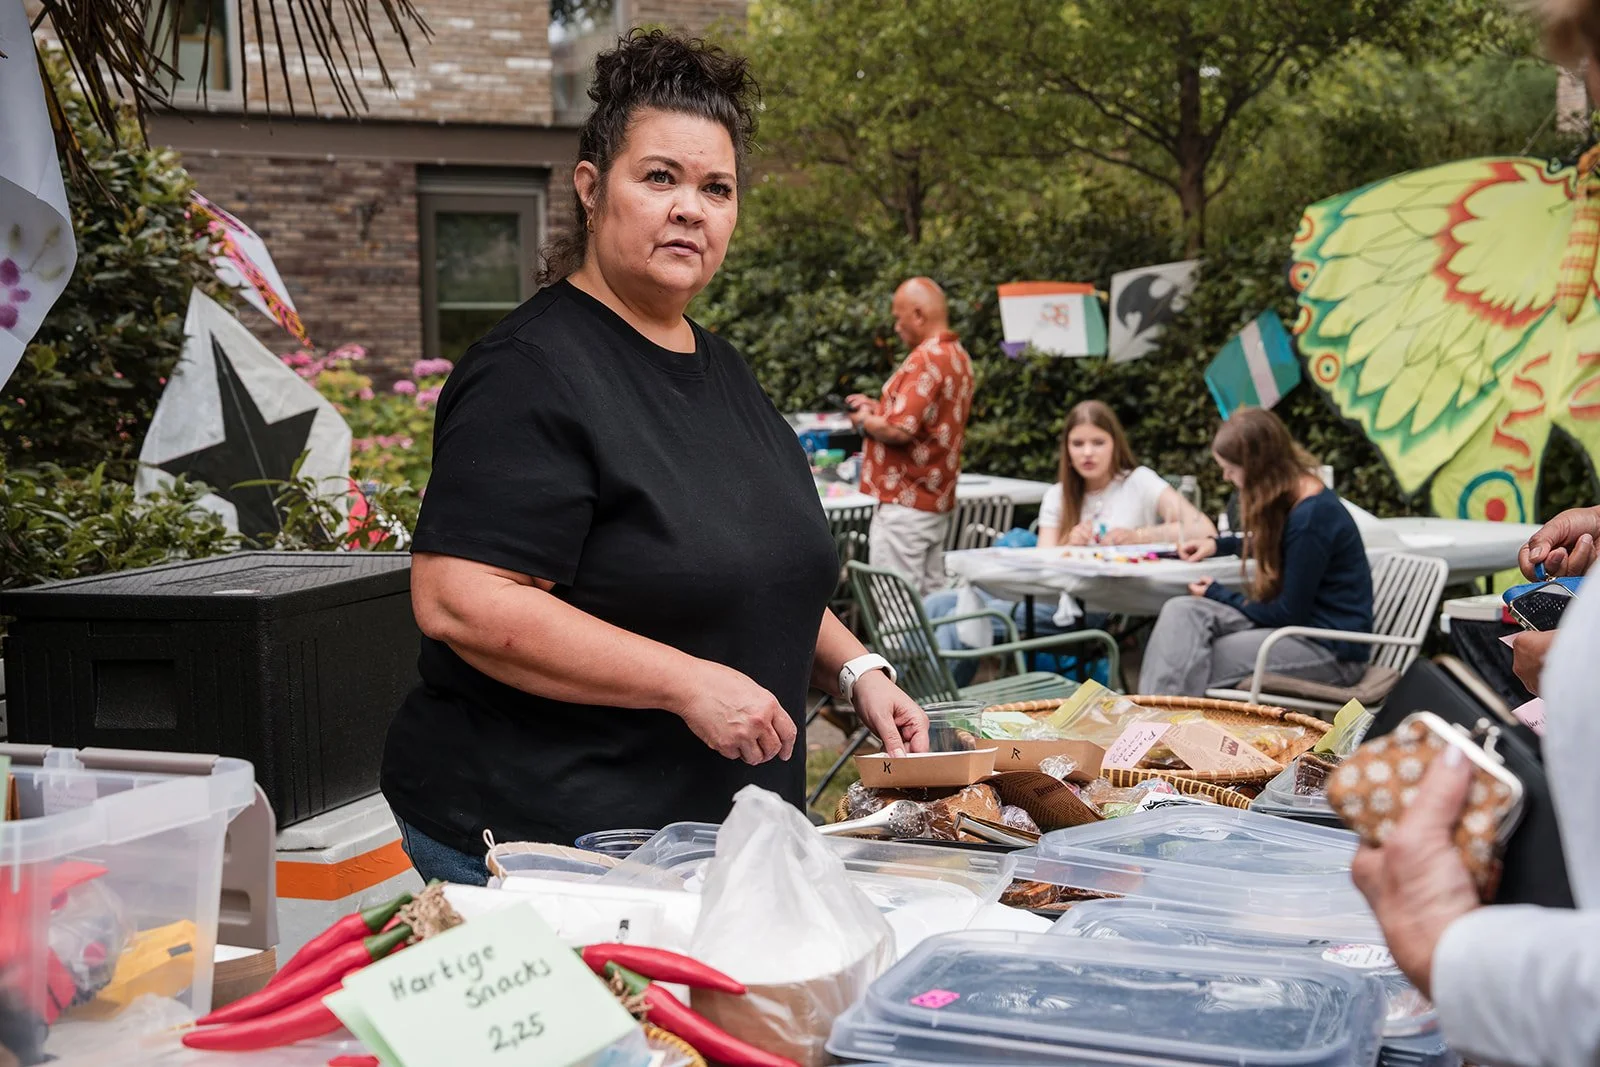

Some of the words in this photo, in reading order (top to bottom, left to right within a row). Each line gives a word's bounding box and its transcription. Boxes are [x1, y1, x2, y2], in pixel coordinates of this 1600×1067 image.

[1011, 747, 1021, 761] R
[883, 761, 892, 775] K
[389, 944, 496, 1001] Hartige
[487, 1012, 545, 1053] 2,25
